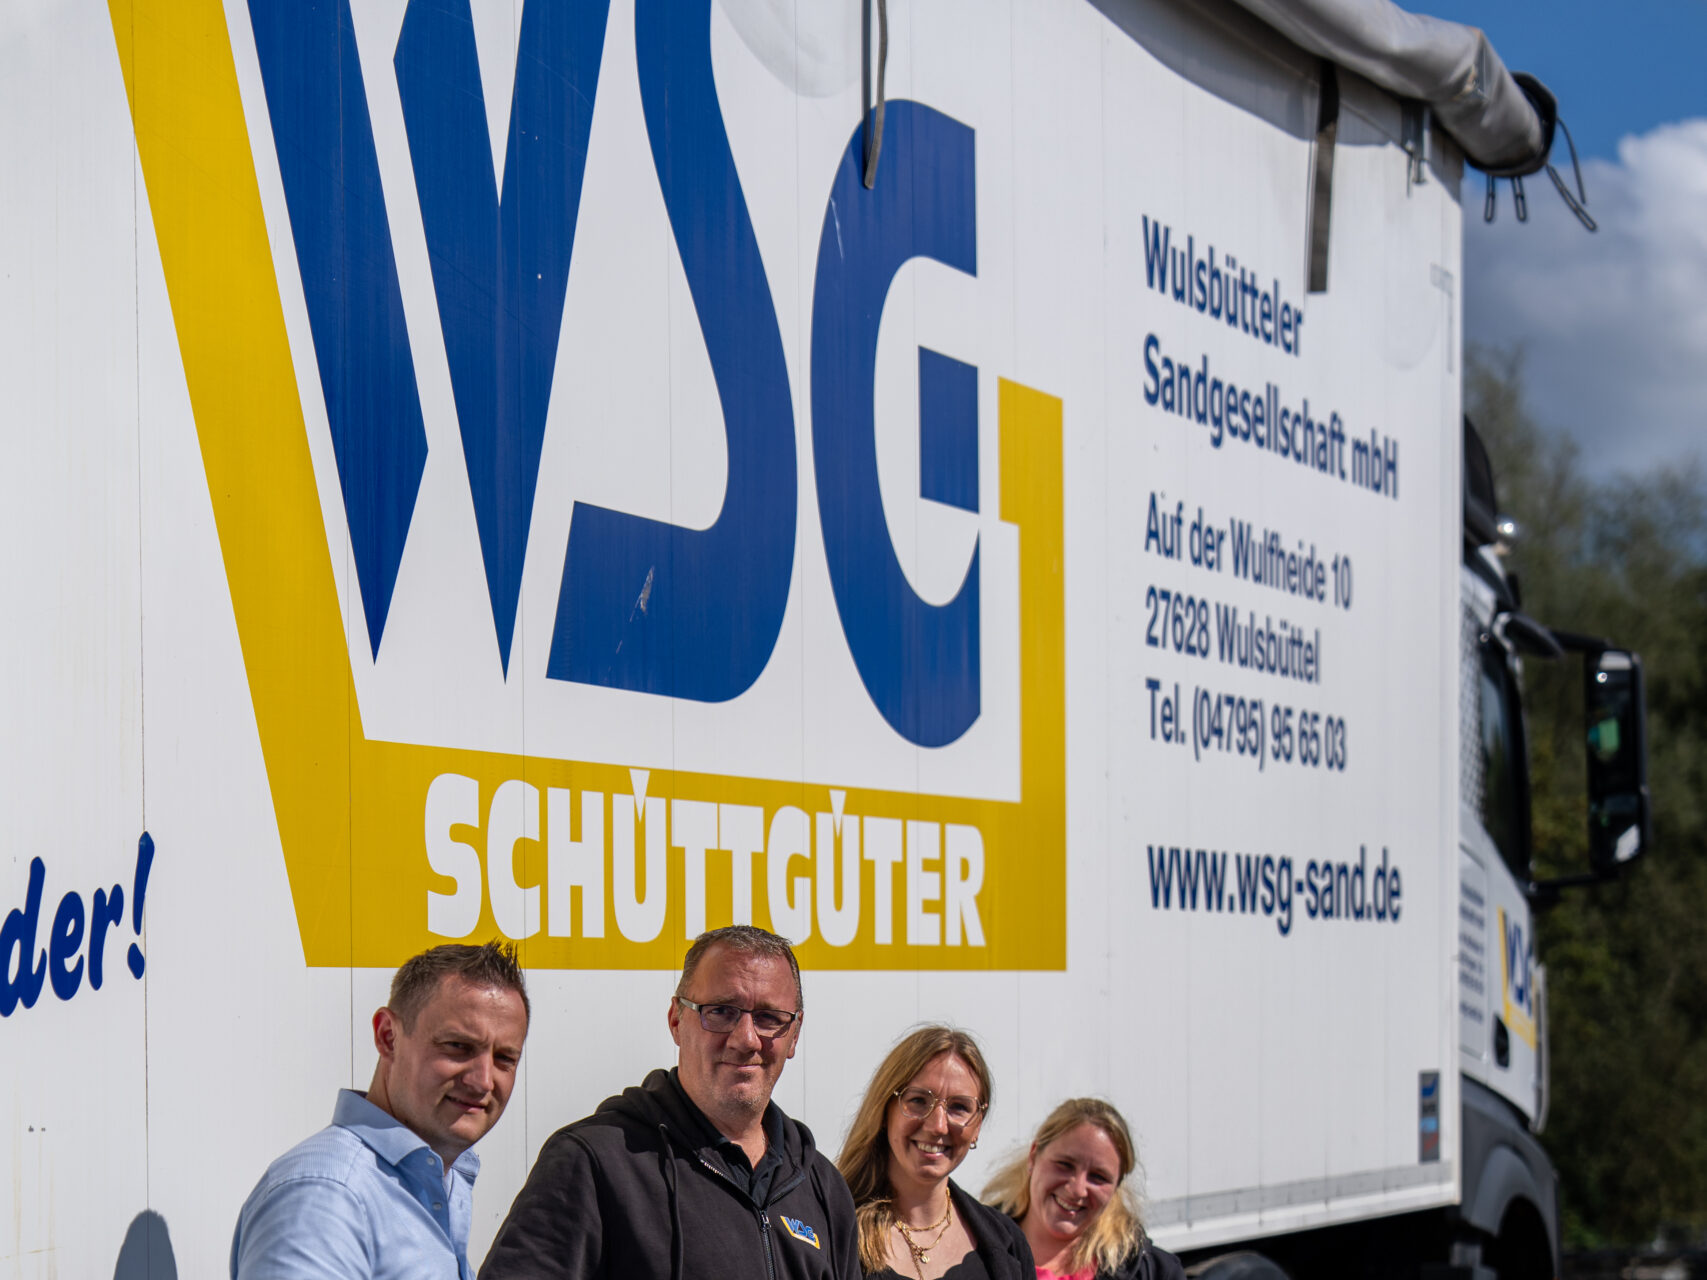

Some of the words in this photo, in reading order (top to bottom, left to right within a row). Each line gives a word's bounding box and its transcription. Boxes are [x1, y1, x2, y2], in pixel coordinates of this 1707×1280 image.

[1142, 214, 1303, 357] Wulsbütteler
[247, 0, 982, 750] WSG
[1143, 333, 1347, 481] Sandgesellschaft
[1351, 428, 1398, 500] mbH
[1144, 492, 1184, 561] Auf
[1189, 507, 1226, 573] der
[1230, 518, 1326, 603] Wulfheide
[1331, 554, 1352, 610] 10
[1145, 585, 1210, 659] 27628
[1215, 602, 1320, 684] Wulsbüttel
[1145, 677, 1186, 745] Tel.
[1192, 686, 1266, 771] (04795)
[1271, 704, 1294, 764] 95
[1298, 710, 1321, 768] 65
[1325, 716, 1347, 772] 03
[1147, 844, 1402, 937] www.wsg-sand.de
